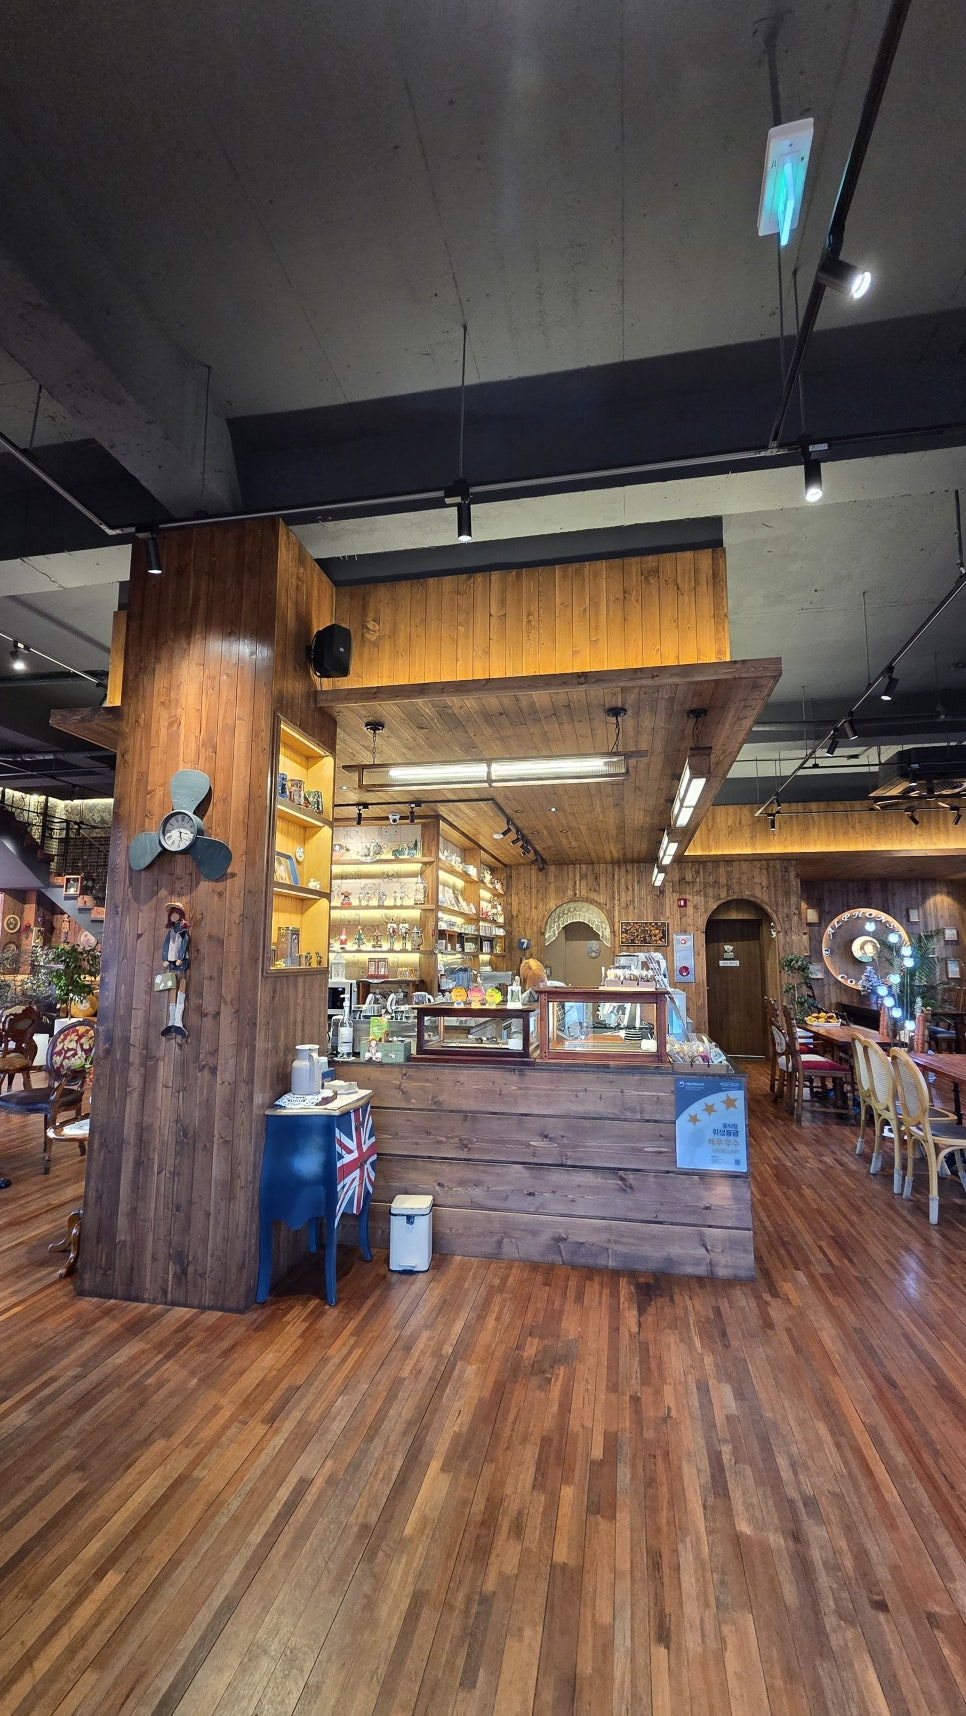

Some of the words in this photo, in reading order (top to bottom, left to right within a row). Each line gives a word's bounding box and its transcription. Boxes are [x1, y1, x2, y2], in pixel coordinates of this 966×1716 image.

[521, 939, 528, 949] 7
[712, 1128, 739, 1137] 위생등급
[708, 1138, 723, 1147] 매우
[725, 1138, 739, 1148] 우수
